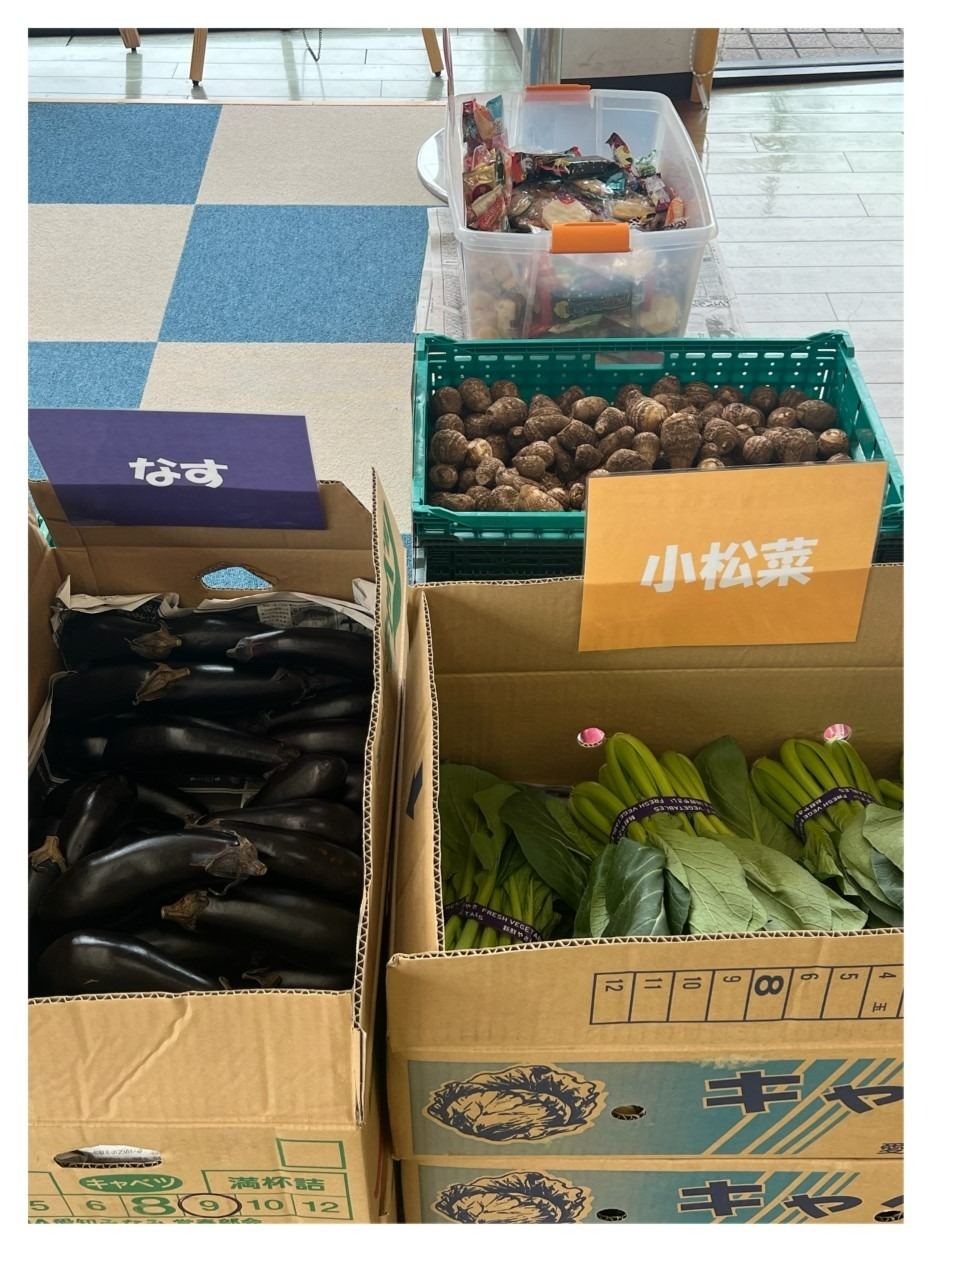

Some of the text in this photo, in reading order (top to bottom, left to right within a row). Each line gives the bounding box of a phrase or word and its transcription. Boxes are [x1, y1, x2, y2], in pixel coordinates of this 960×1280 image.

[128, 456, 229, 490] なす
[639, 536, 819, 594] 小松菜
[823, 793, 848, 808] FRESH
[481, 907, 509, 923] FRESH
[682, 976, 702, 990] 10
[722, 975, 742, 984] 9
[800, 972, 819, 981] 6
[839, 971, 859, 981] 5
[877, 971, 897, 980] 4
[605, 978, 624, 993] 12
[644, 977, 663, 991] 11
[754, 974, 785, 996] 8
[703, 1070, 904, 1114] キャ
[84, 1174, 176, 1190] キャベツ
[228, 1176, 326, 1192] 満杯詰
[29, 1196, 340, 1216] 5 6 8 9 10 12
[679, 1179, 904, 1219] キャ
